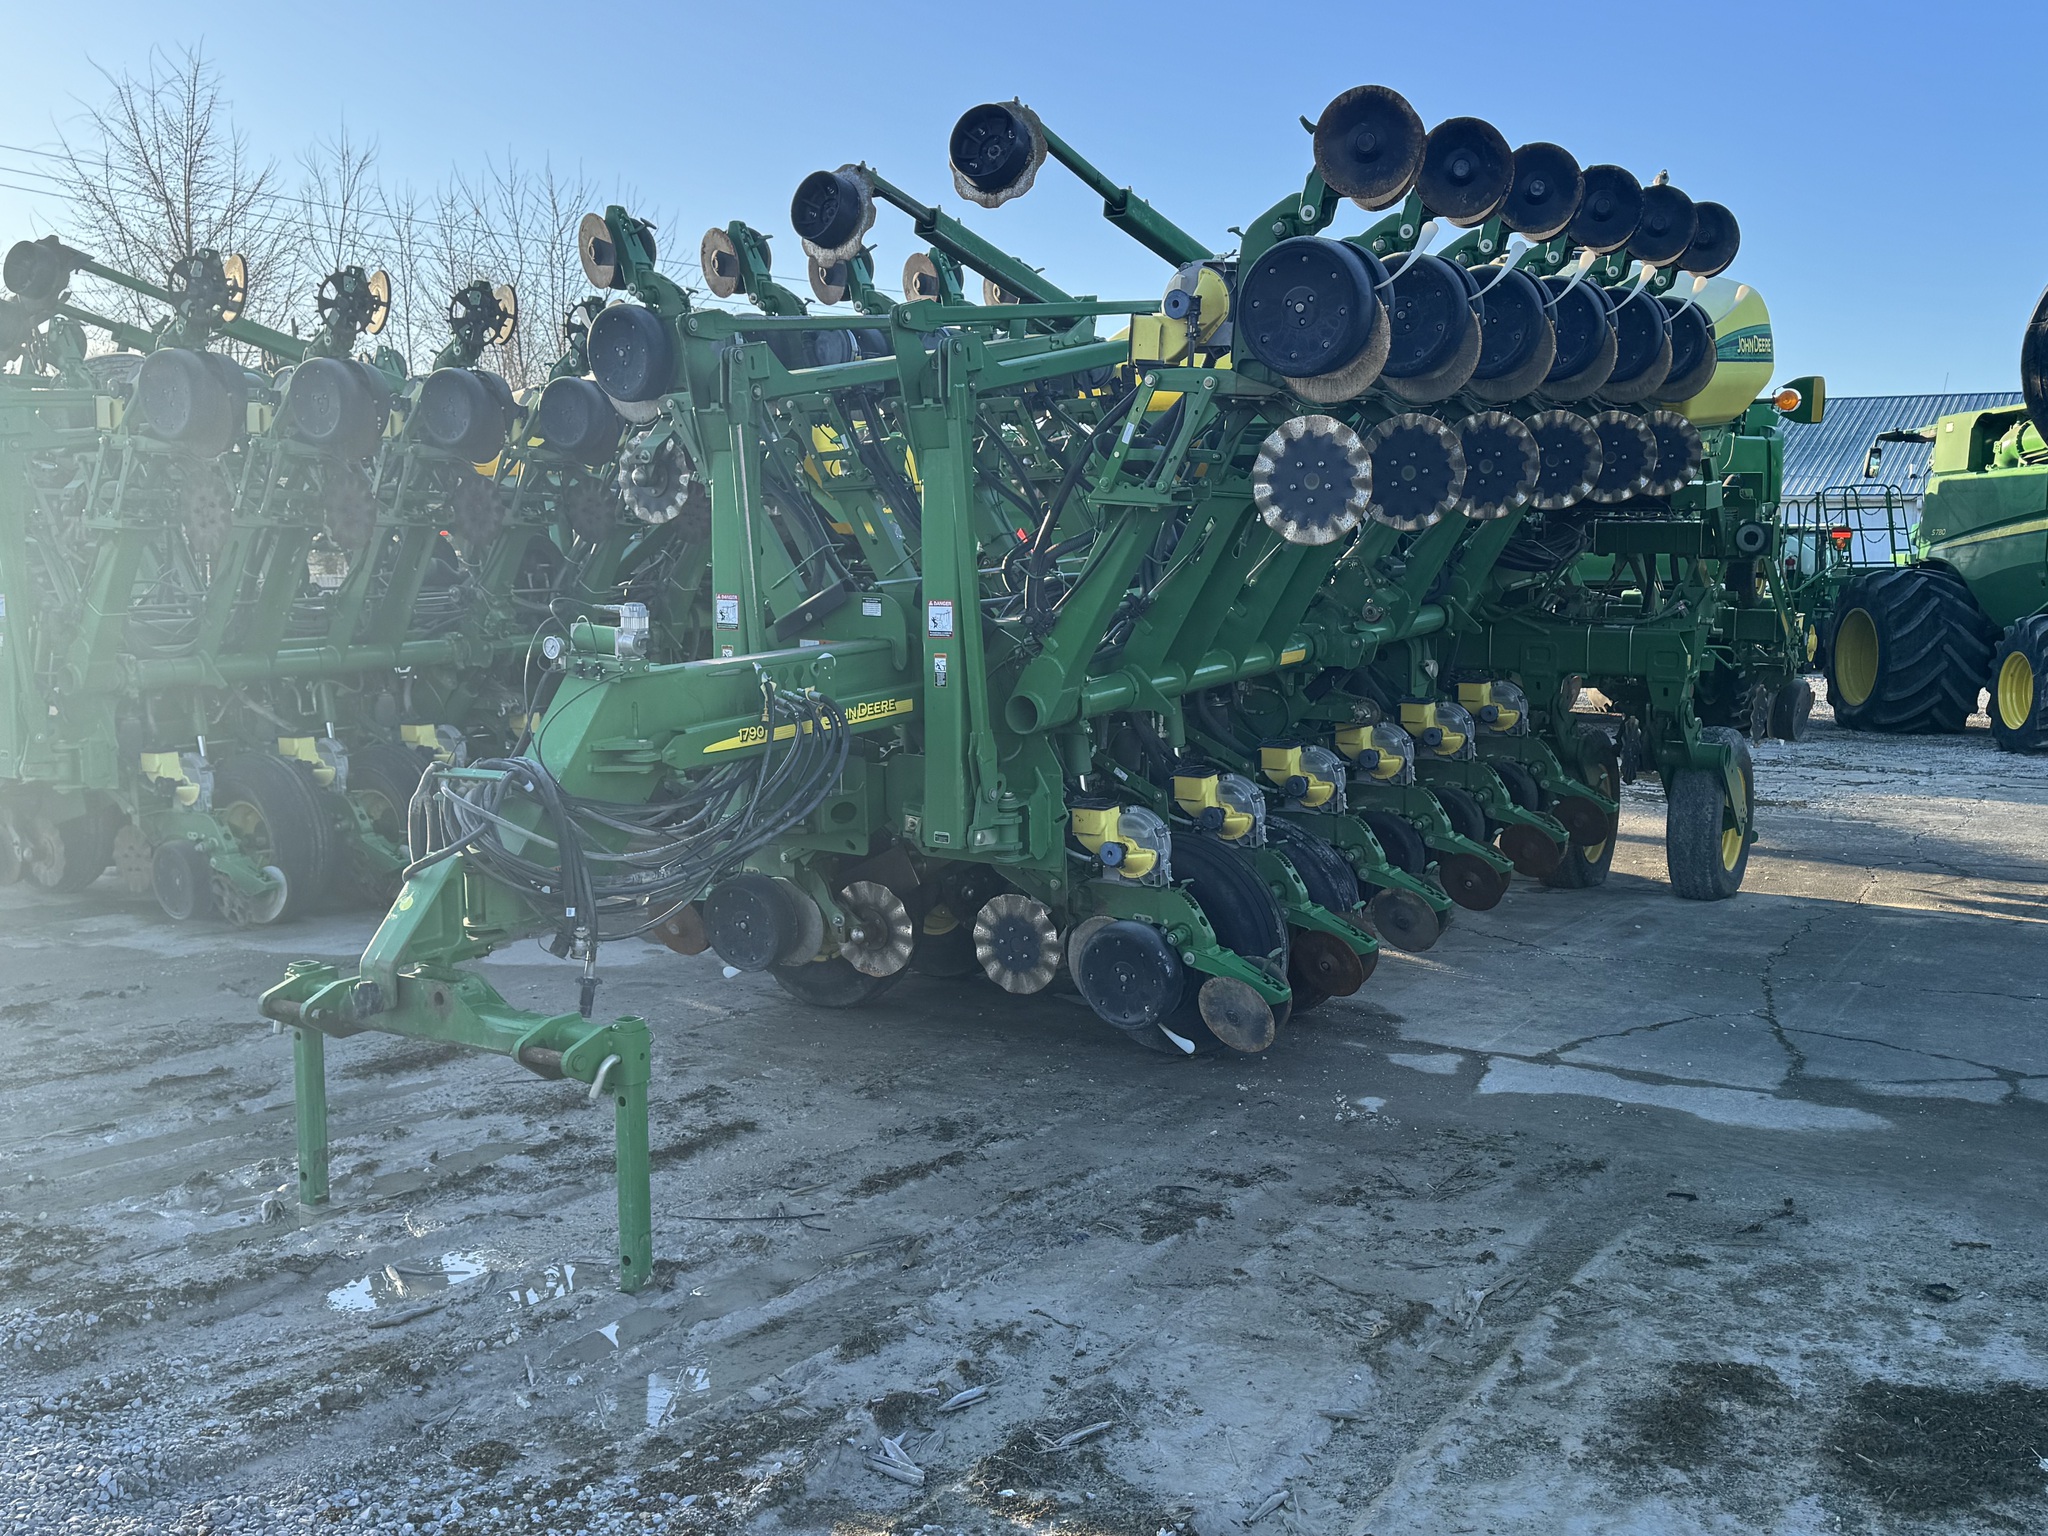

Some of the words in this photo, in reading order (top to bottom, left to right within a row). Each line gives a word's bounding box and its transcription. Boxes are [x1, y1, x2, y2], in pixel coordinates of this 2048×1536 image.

[1737, 335, 1754, 353] JOHN
[1754, 335, 1771, 353] DEERE
[738, 725, 765, 742] 1790
[858, 699, 895, 717] DEERE
